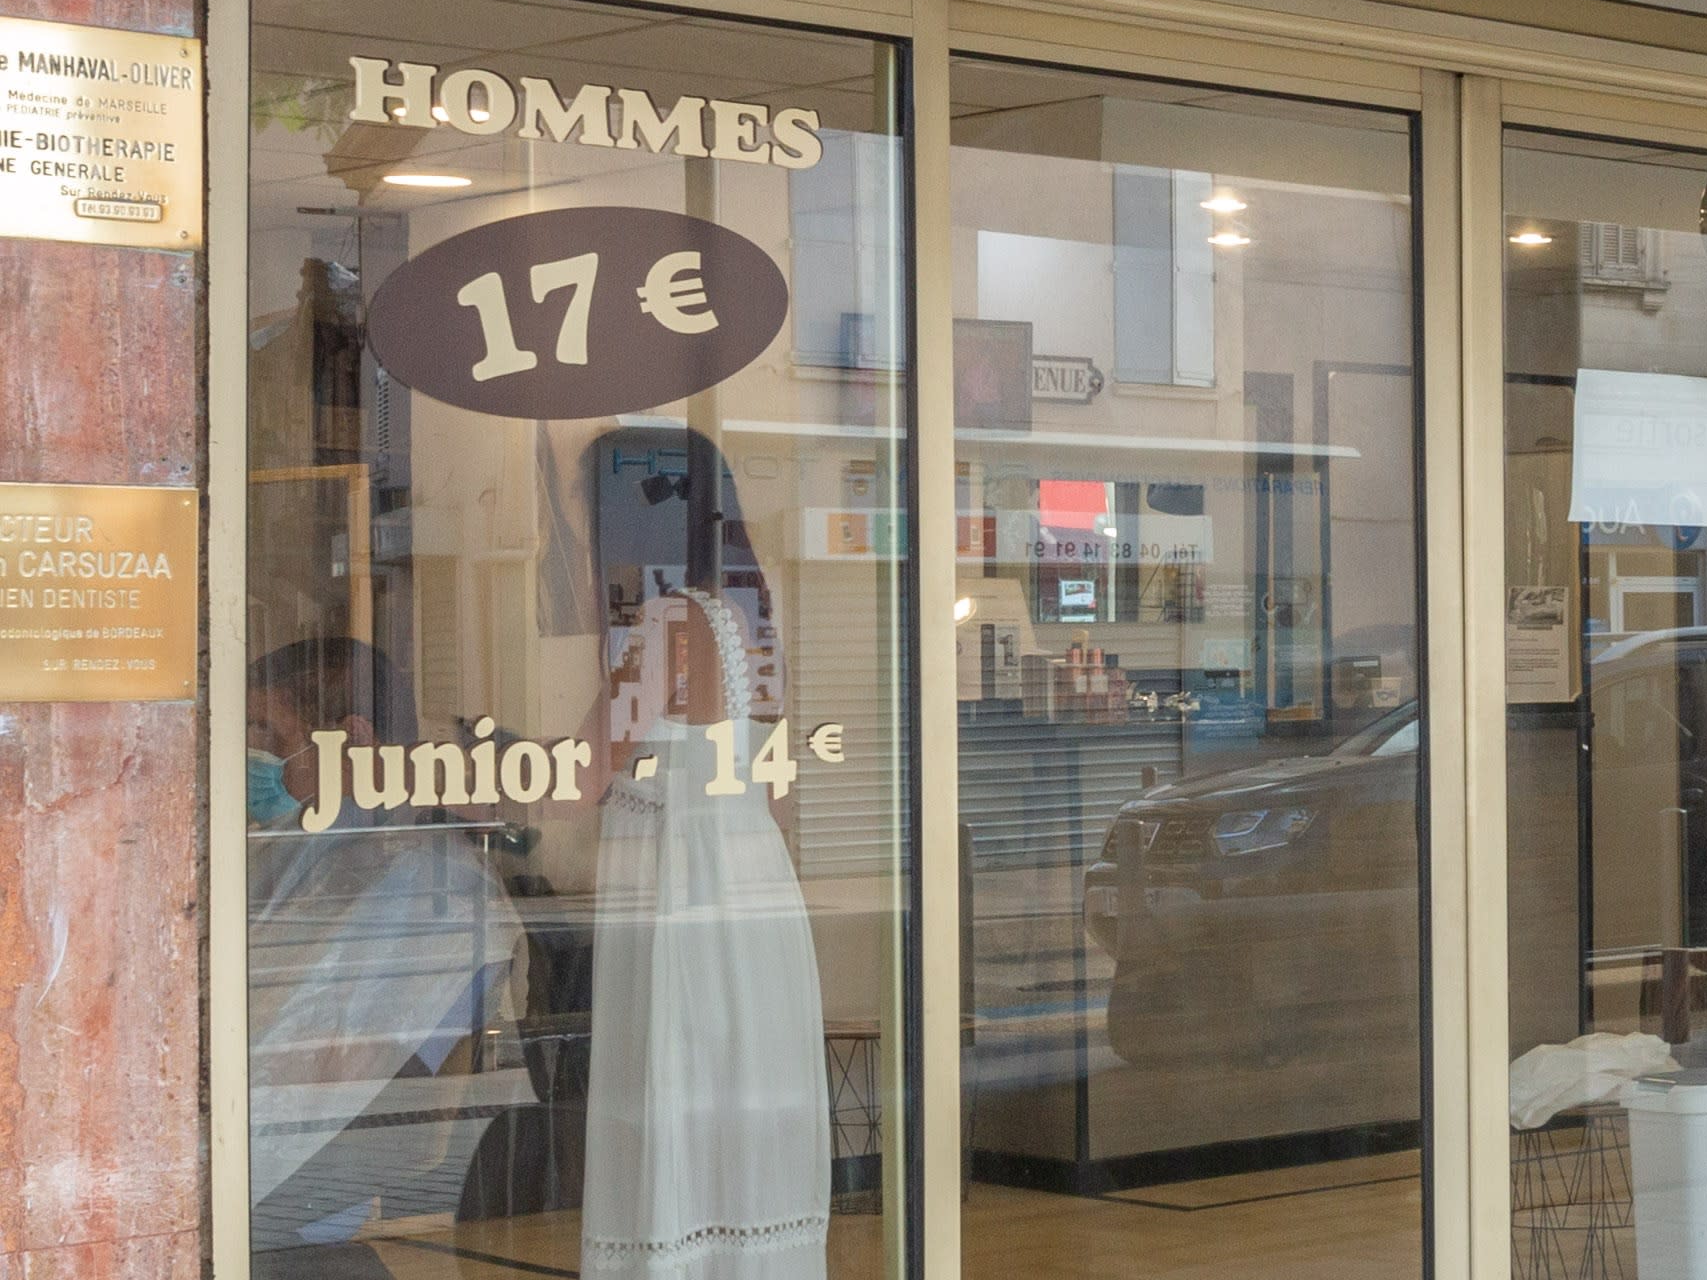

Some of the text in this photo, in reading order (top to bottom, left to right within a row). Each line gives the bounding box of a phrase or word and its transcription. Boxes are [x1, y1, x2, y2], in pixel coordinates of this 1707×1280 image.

[18, 50, 193, 91] MANHAVAL-OLIVER
[76, 97, 91, 117] de
[99, 97, 168, 116] MARSEILLE
[347, 56, 825, 170] HOMMES
[30, 160, 125, 183] GENERALE
[456, 250, 720, 383] 17 €
[17, 550, 173, 580] CARSUZAA
[42, 587, 142, 610] DENTISTE
[101, 626, 166, 640] BORDEAUX
[301, 715, 592, 833] Junior
